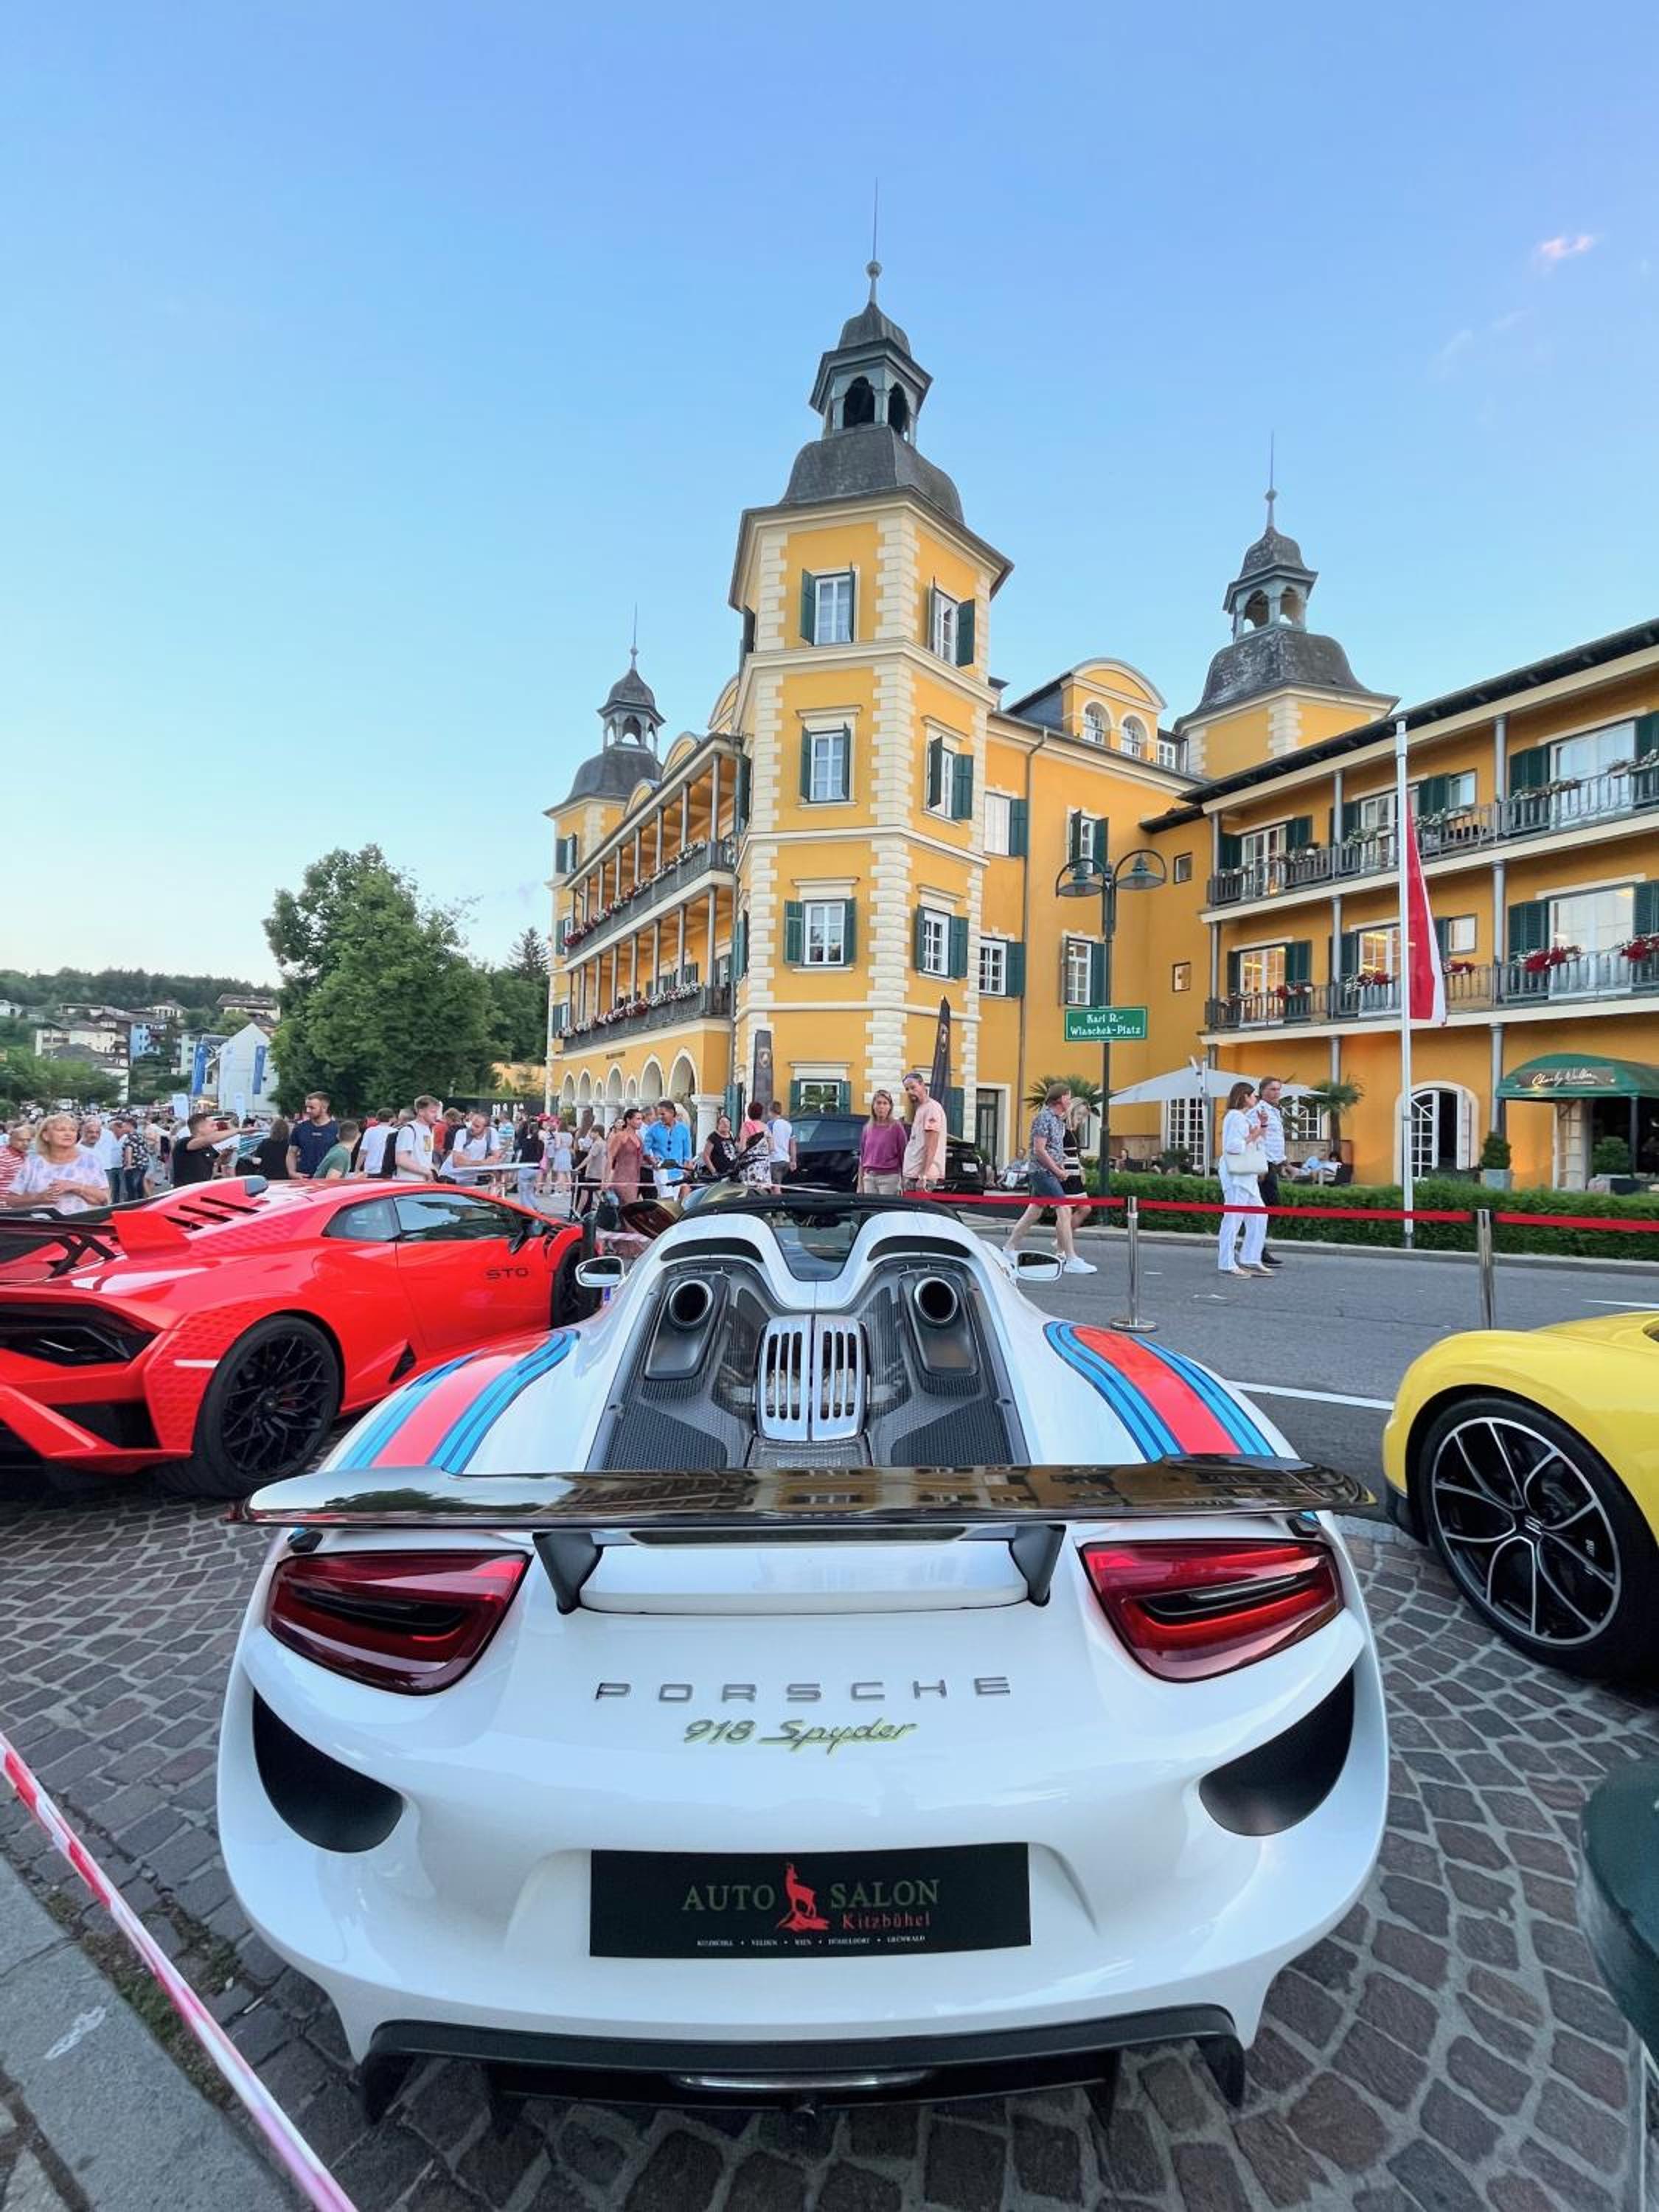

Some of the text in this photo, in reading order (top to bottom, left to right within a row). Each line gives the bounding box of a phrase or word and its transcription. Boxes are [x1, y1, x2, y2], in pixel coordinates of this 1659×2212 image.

[1086, 1014, 1105, 1023] Karl
[486, 1267, 529, 1279] STO
[594, 1677, 1012, 1703] PORSCHE
[684, 1717, 917, 1754] 918 Spyder
[681, 1879, 940, 1911] AUTO SALON
[843, 1911, 931, 1930] Kitzbühel
